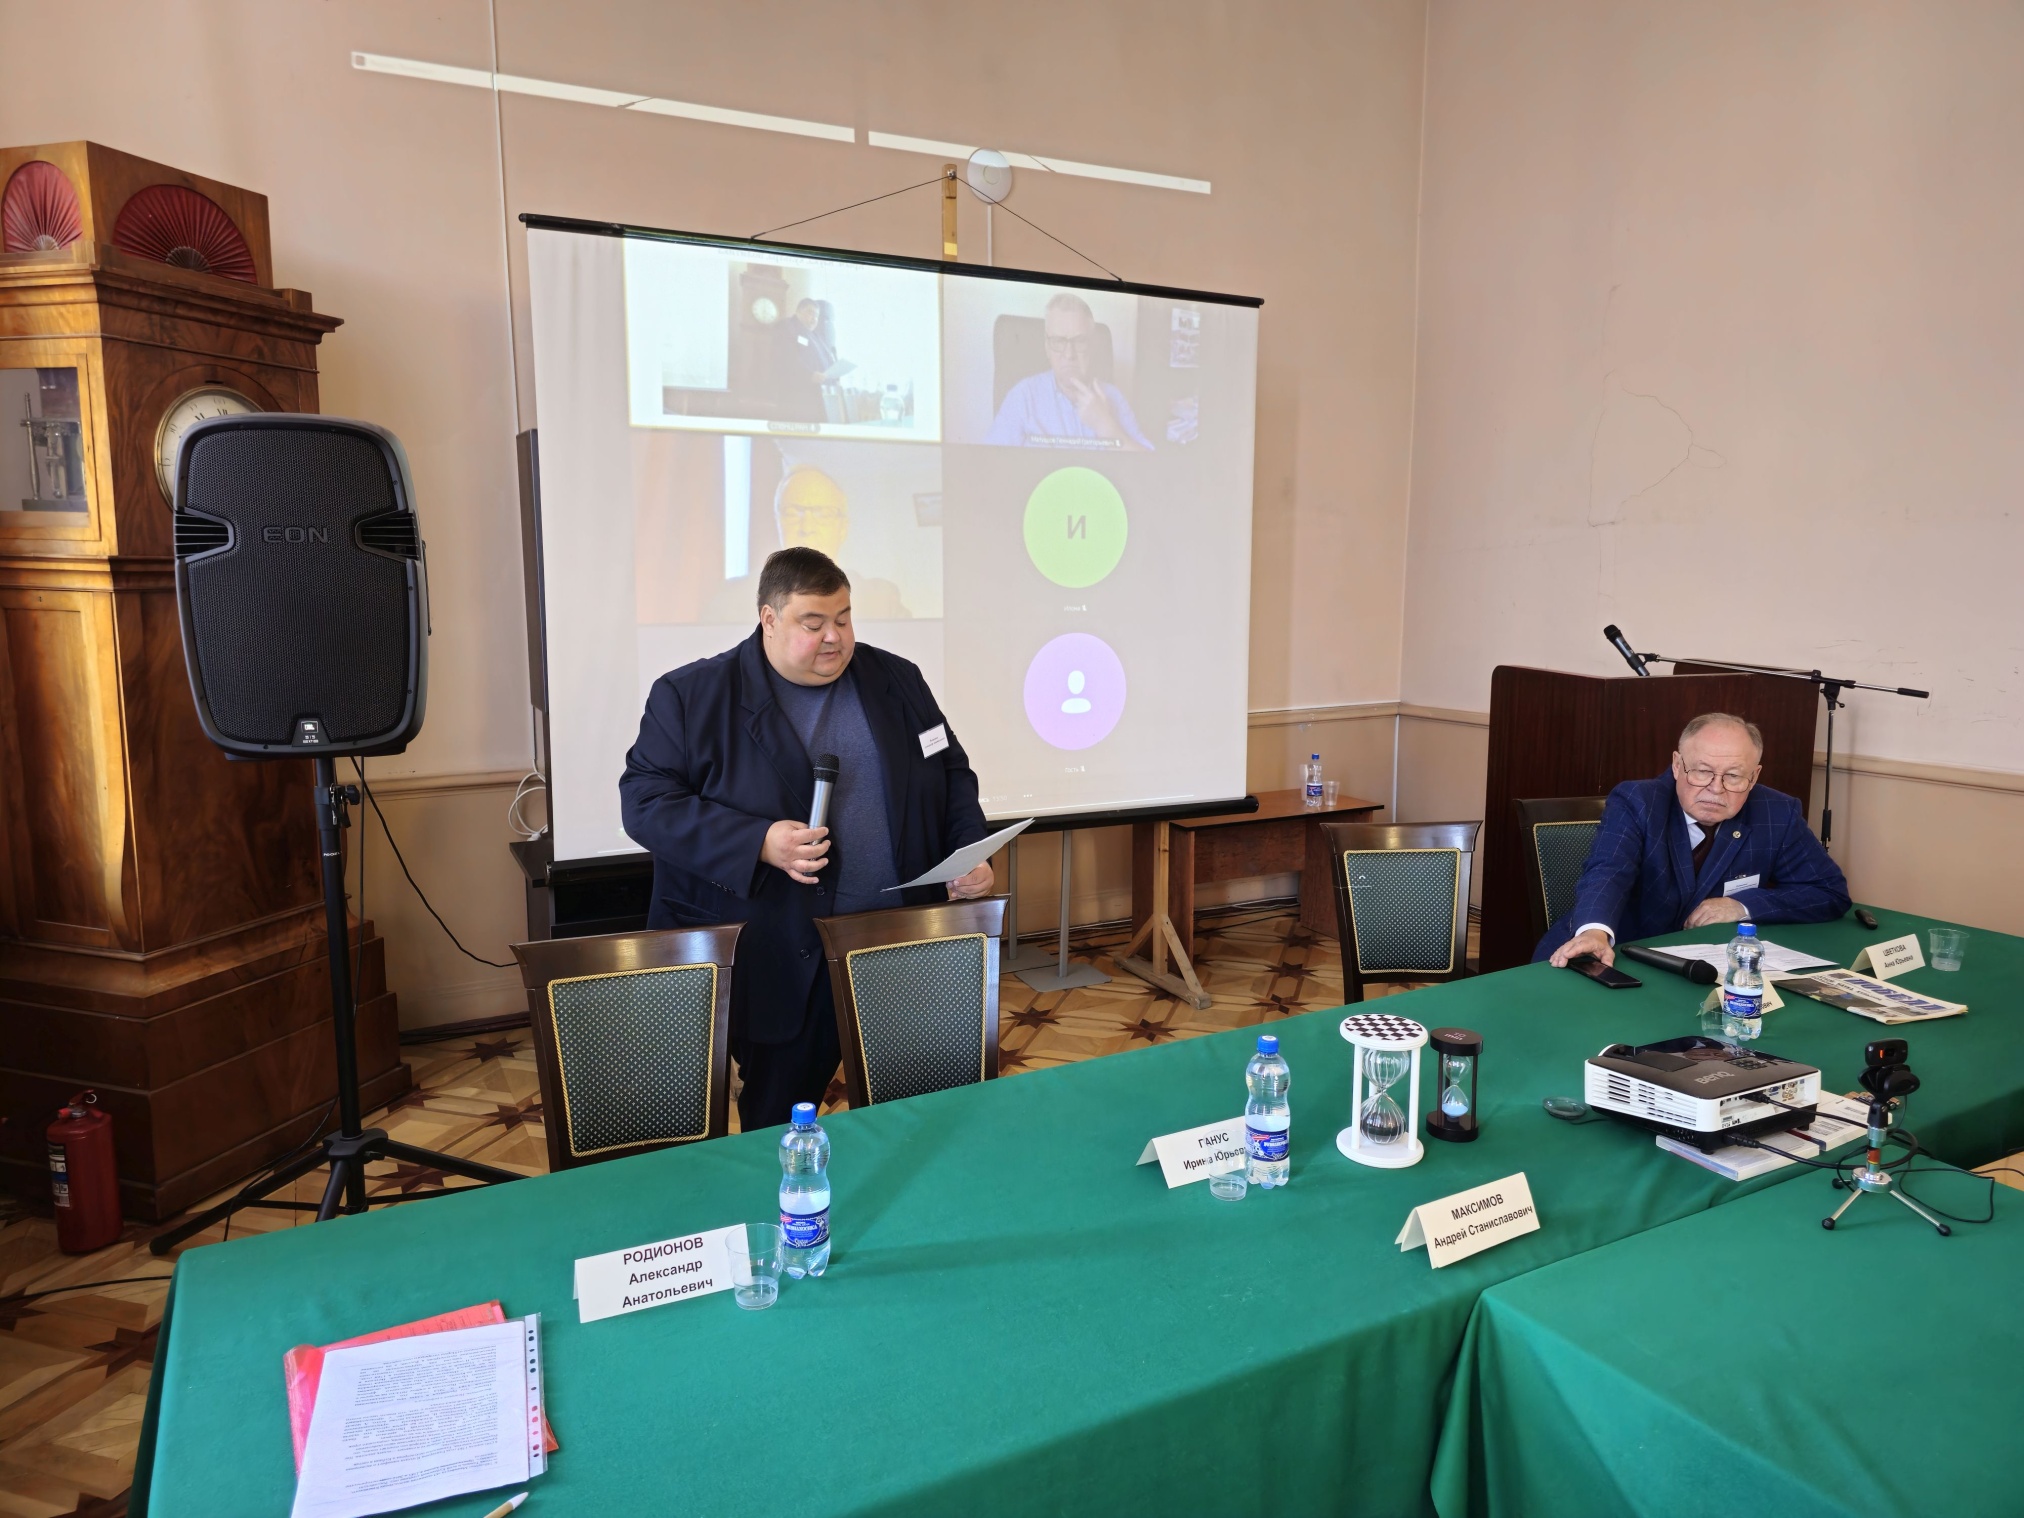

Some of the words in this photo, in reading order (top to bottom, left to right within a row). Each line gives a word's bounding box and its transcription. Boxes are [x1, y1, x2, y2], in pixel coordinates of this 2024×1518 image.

[263, 525, 329, 544] EON
[1067, 514, 1087, 540] И
[1882, 944, 1907, 957] ЦВЕТКОВА
[1895, 955, 1914, 966] Юрьевна
[1694, 1071, 1735, 1085] BenQ
[1198, 1132, 1229, 1148] ГАНУС
[1183, 1156, 1214, 1171] Ирина
[1214, 1147, 1246, 1162] Юрьев
[1450, 1193, 1504, 1221] МАКСИМОВ
[1433, 1228, 1468, 1249] Андрей
[1467, 1205, 1533, 1236] Станиславович
[623, 1236, 704, 1265] РОДИОНОВ
[629, 1260, 703, 1286] Александр
[622, 1278, 713, 1308] Анатольевич
